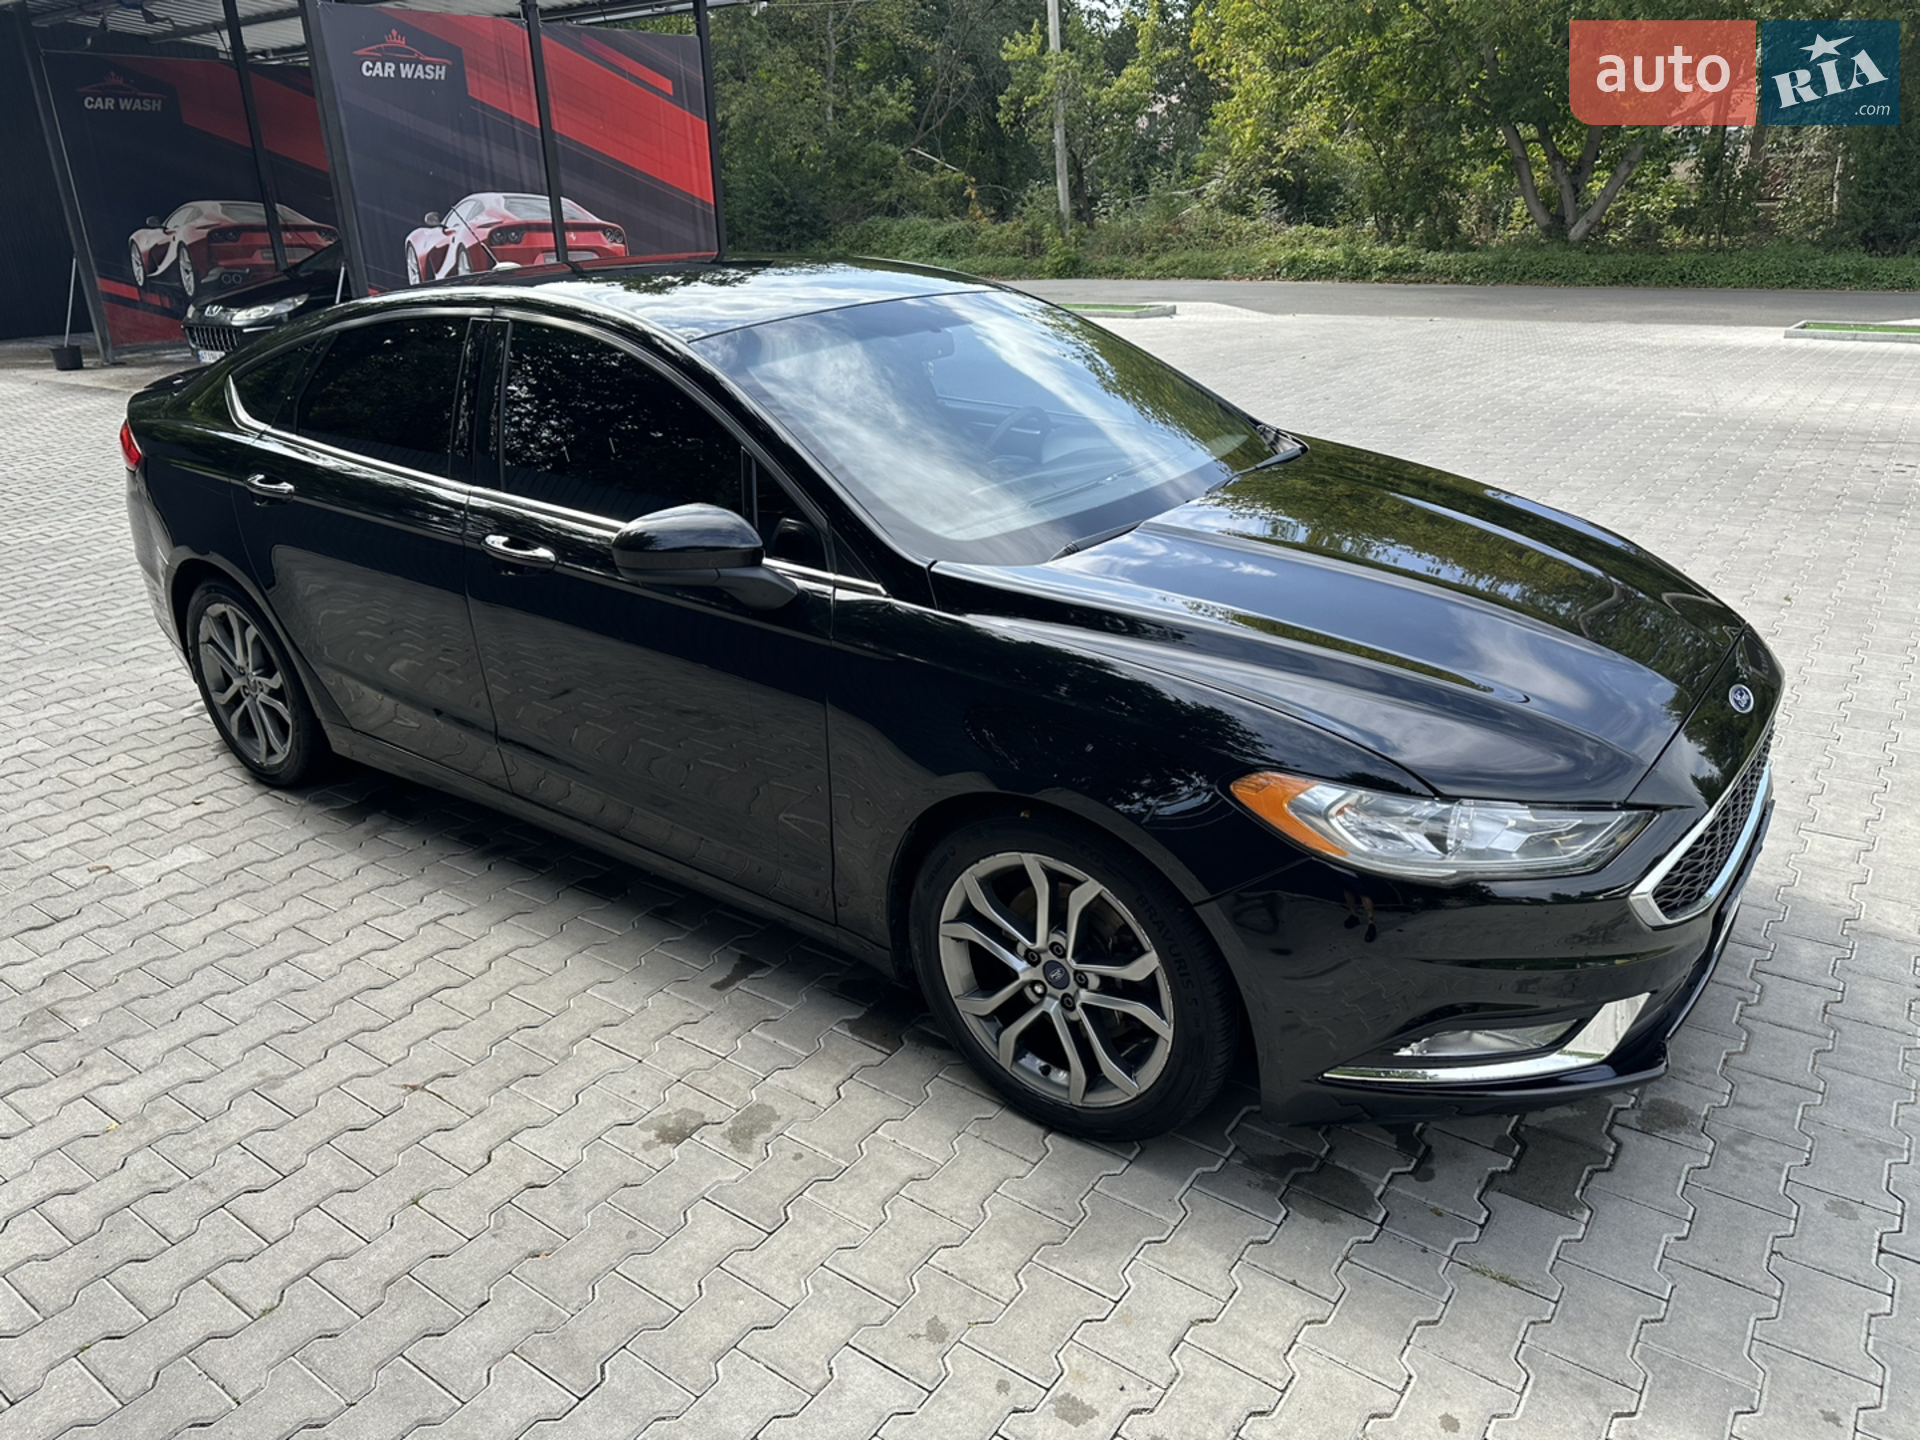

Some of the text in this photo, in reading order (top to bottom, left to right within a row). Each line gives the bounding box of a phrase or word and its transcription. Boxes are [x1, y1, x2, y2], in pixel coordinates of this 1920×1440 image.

[361, 60, 447, 80] CAR WASH
[83, 96, 163, 112] CAR WASH
[1135, 894, 1195, 990] BRAVURIS
